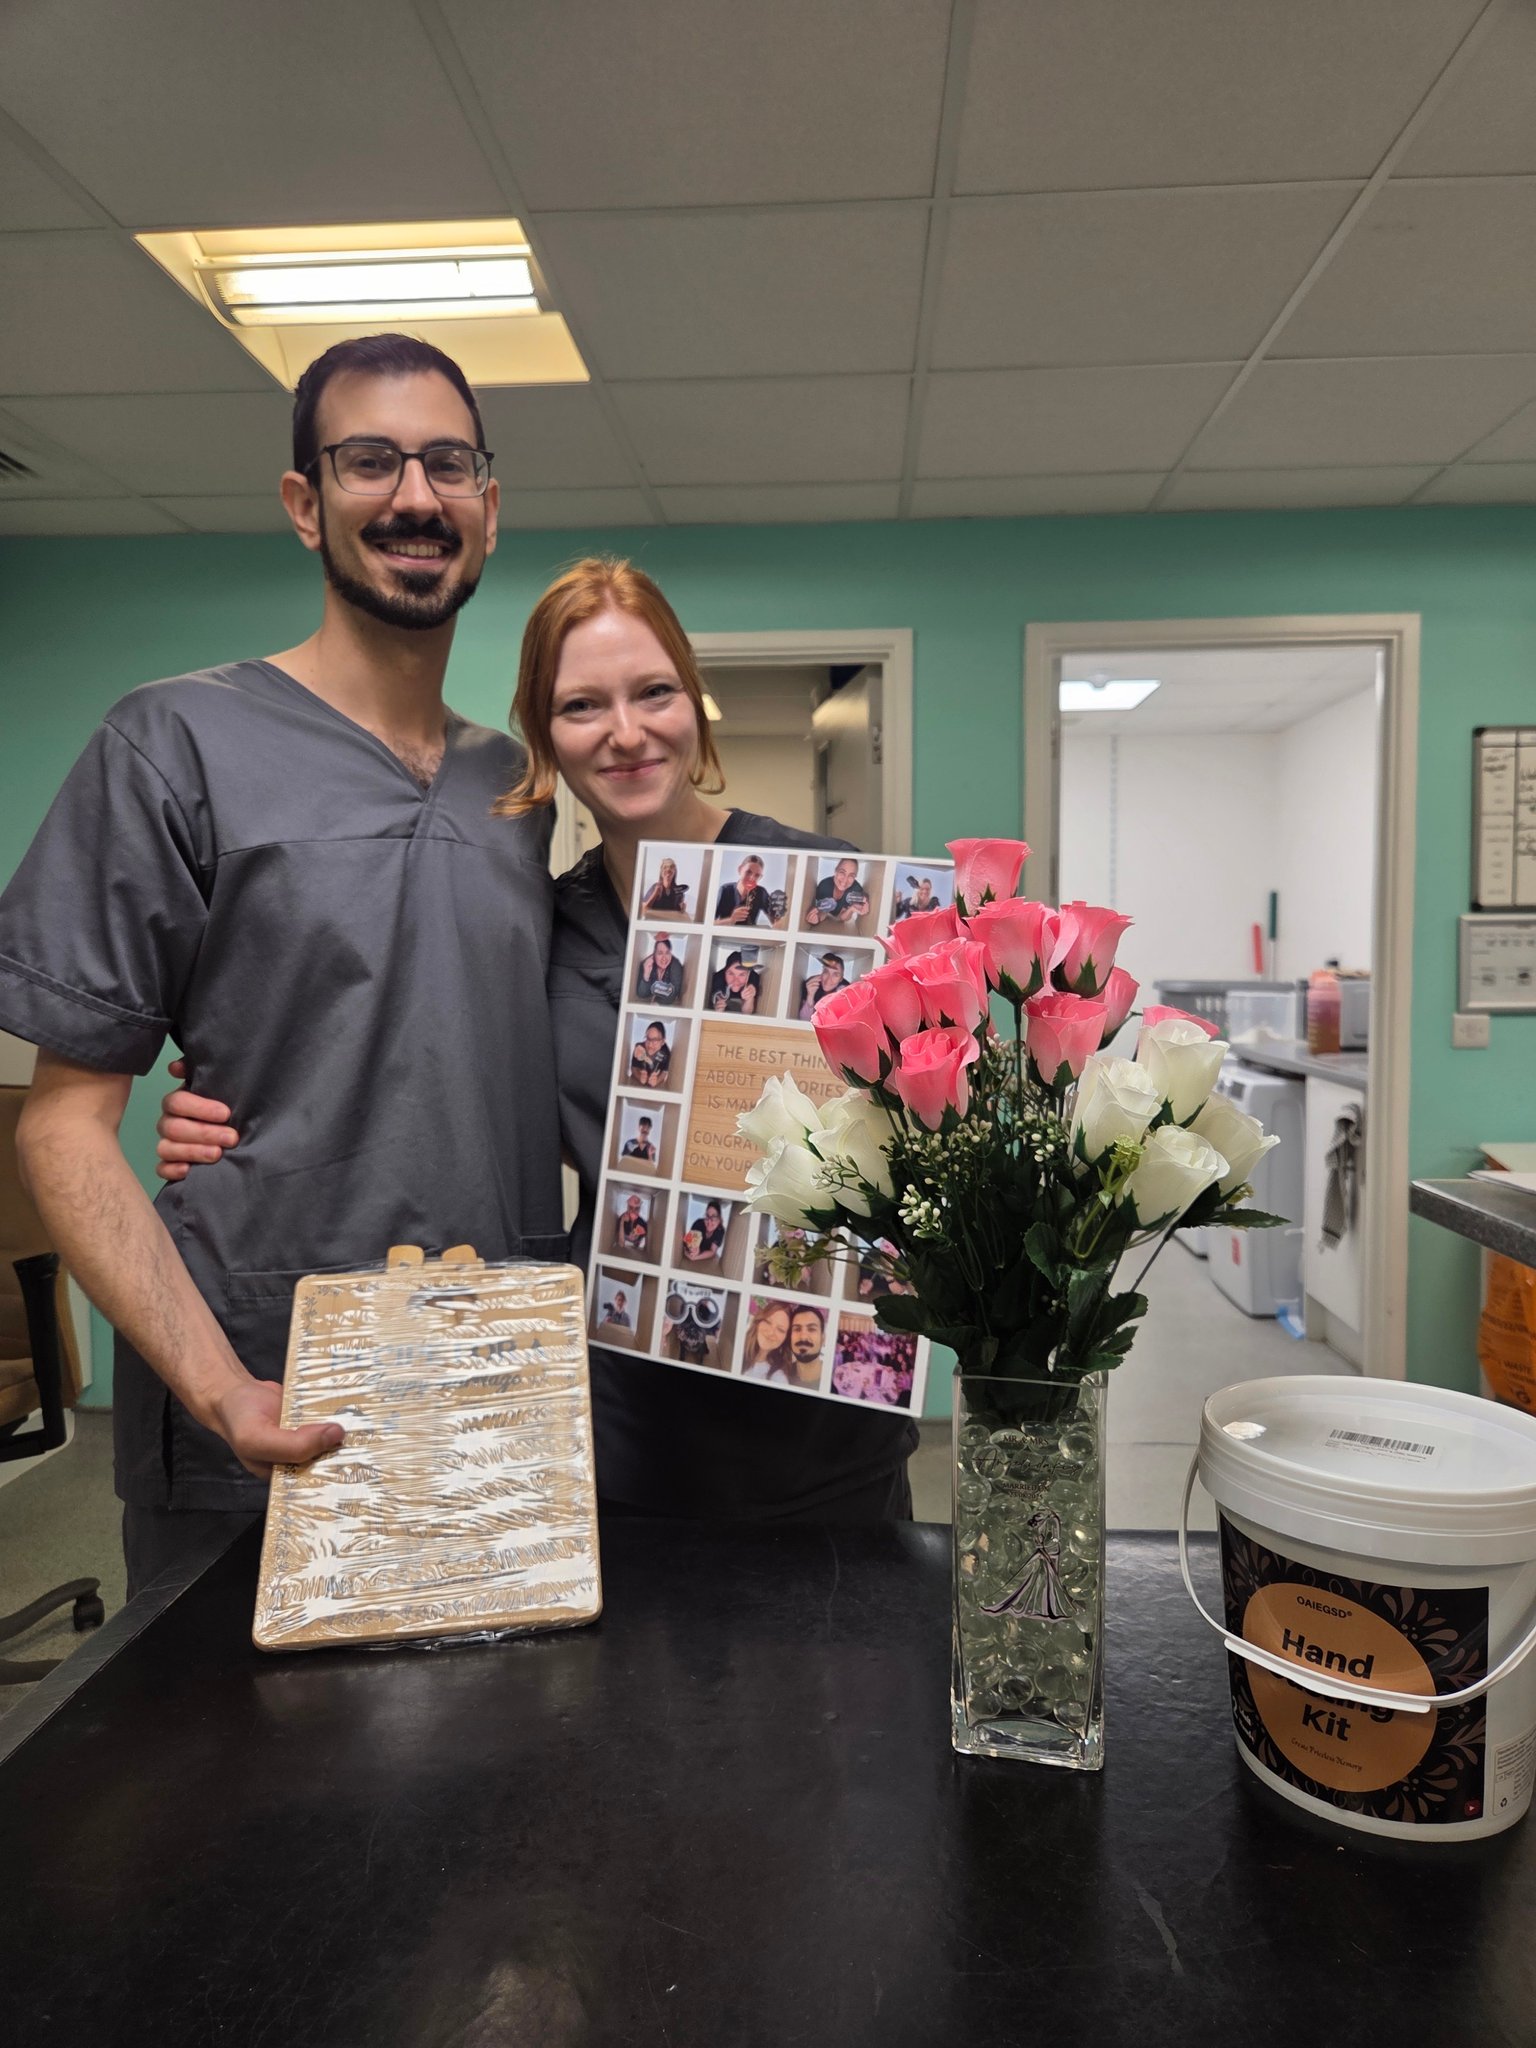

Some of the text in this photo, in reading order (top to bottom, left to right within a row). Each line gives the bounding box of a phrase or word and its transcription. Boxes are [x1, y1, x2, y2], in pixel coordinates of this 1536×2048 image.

[716, 1044, 829, 1070] THE BEST THIN
[705, 1070, 757, 1087] ABOUT
[707, 1095, 720, 1109] IS
[689, 1152, 710, 1167] ON
[1281, 1628, 1375, 1680] Hand
[1302, 1703, 1351, 1742] Kit
